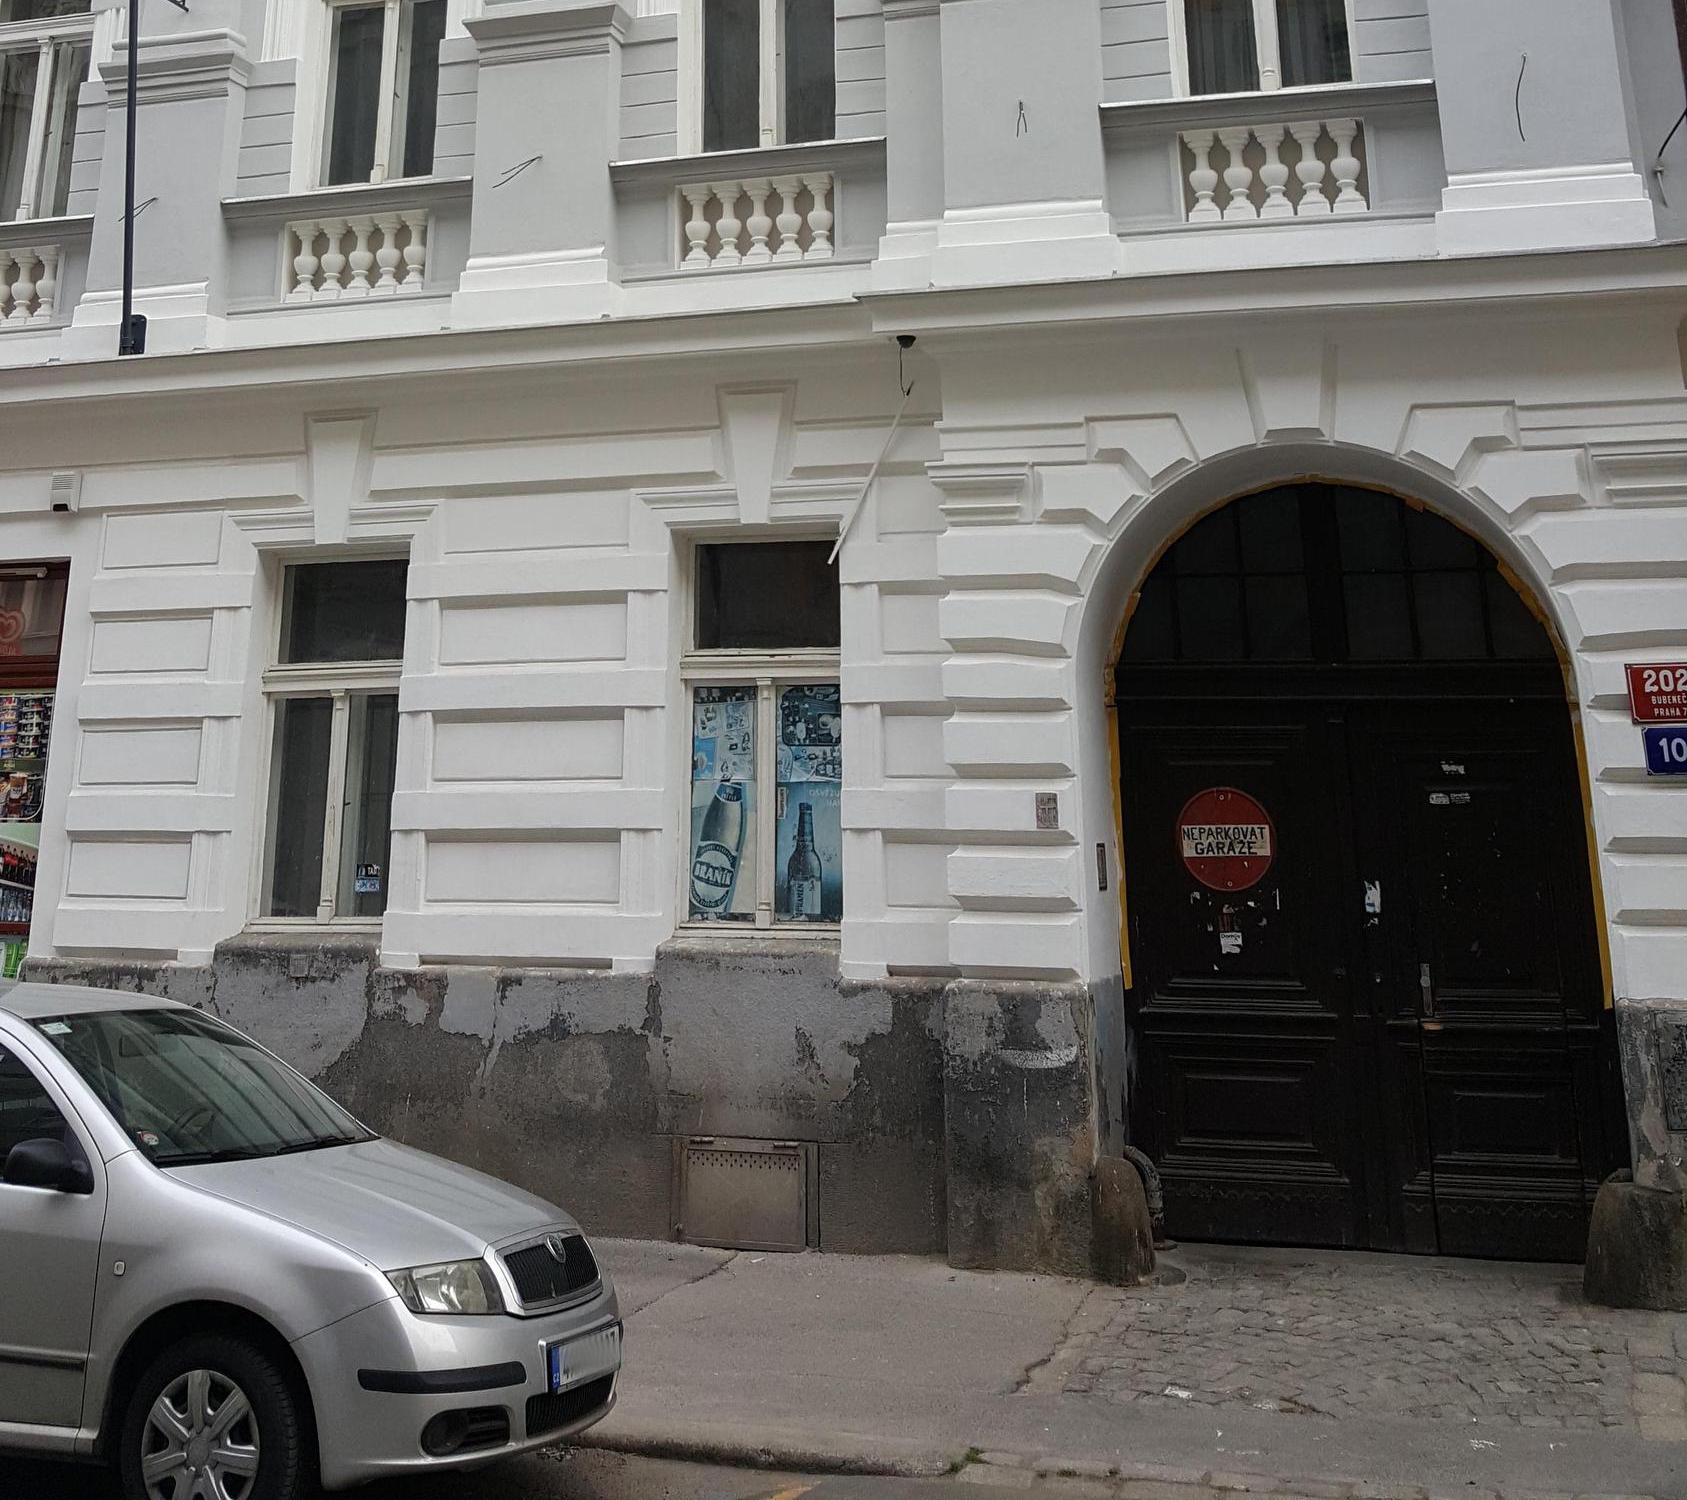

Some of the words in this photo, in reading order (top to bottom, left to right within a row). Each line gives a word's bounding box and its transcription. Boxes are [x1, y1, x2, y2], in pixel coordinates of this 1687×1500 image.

[1654, 707, 1681, 717] PRAHA
[1659, 737, 1687, 763] 10
[1182, 826, 1266, 841] NEPARKOVAT
